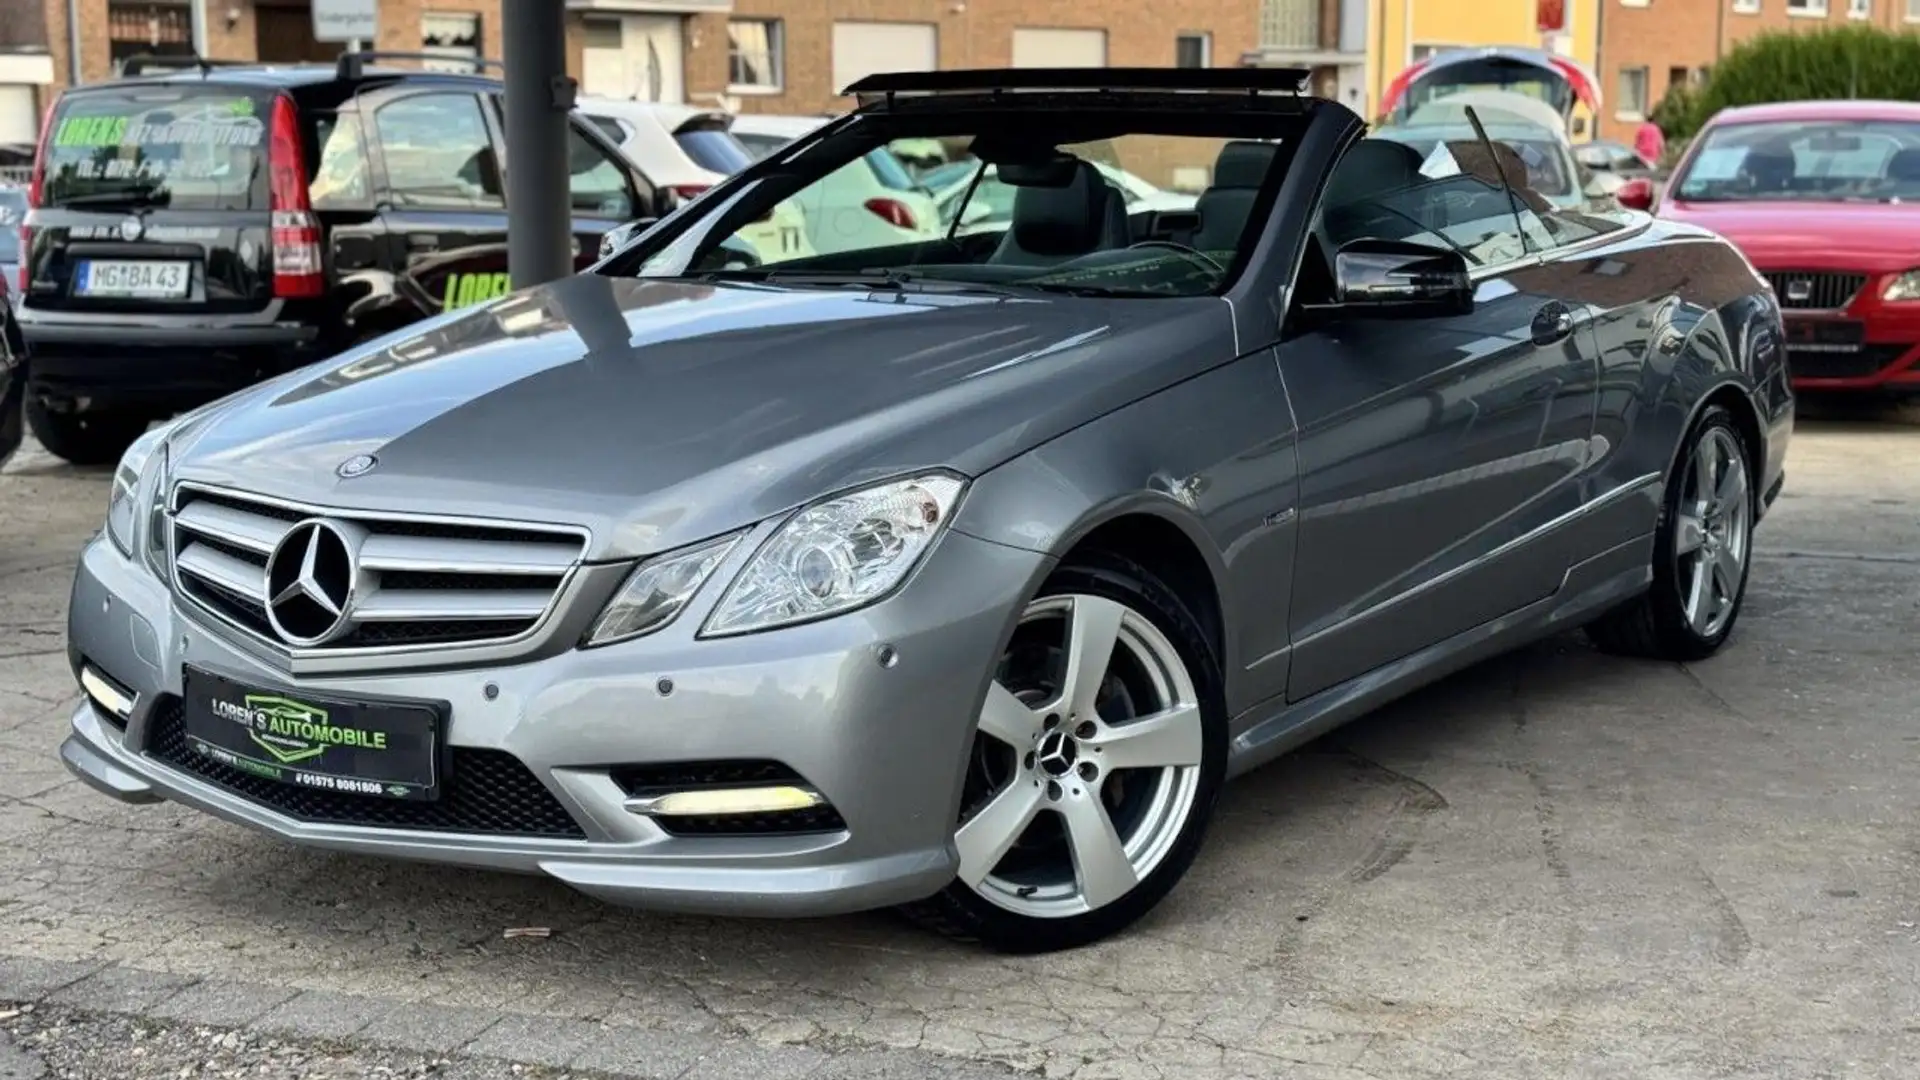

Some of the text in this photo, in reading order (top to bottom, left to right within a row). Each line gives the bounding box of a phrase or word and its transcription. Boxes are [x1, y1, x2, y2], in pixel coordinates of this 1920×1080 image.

[94, 265, 181, 289] MG BA 43
[268, 717, 387, 749] AUTOMOBILE
